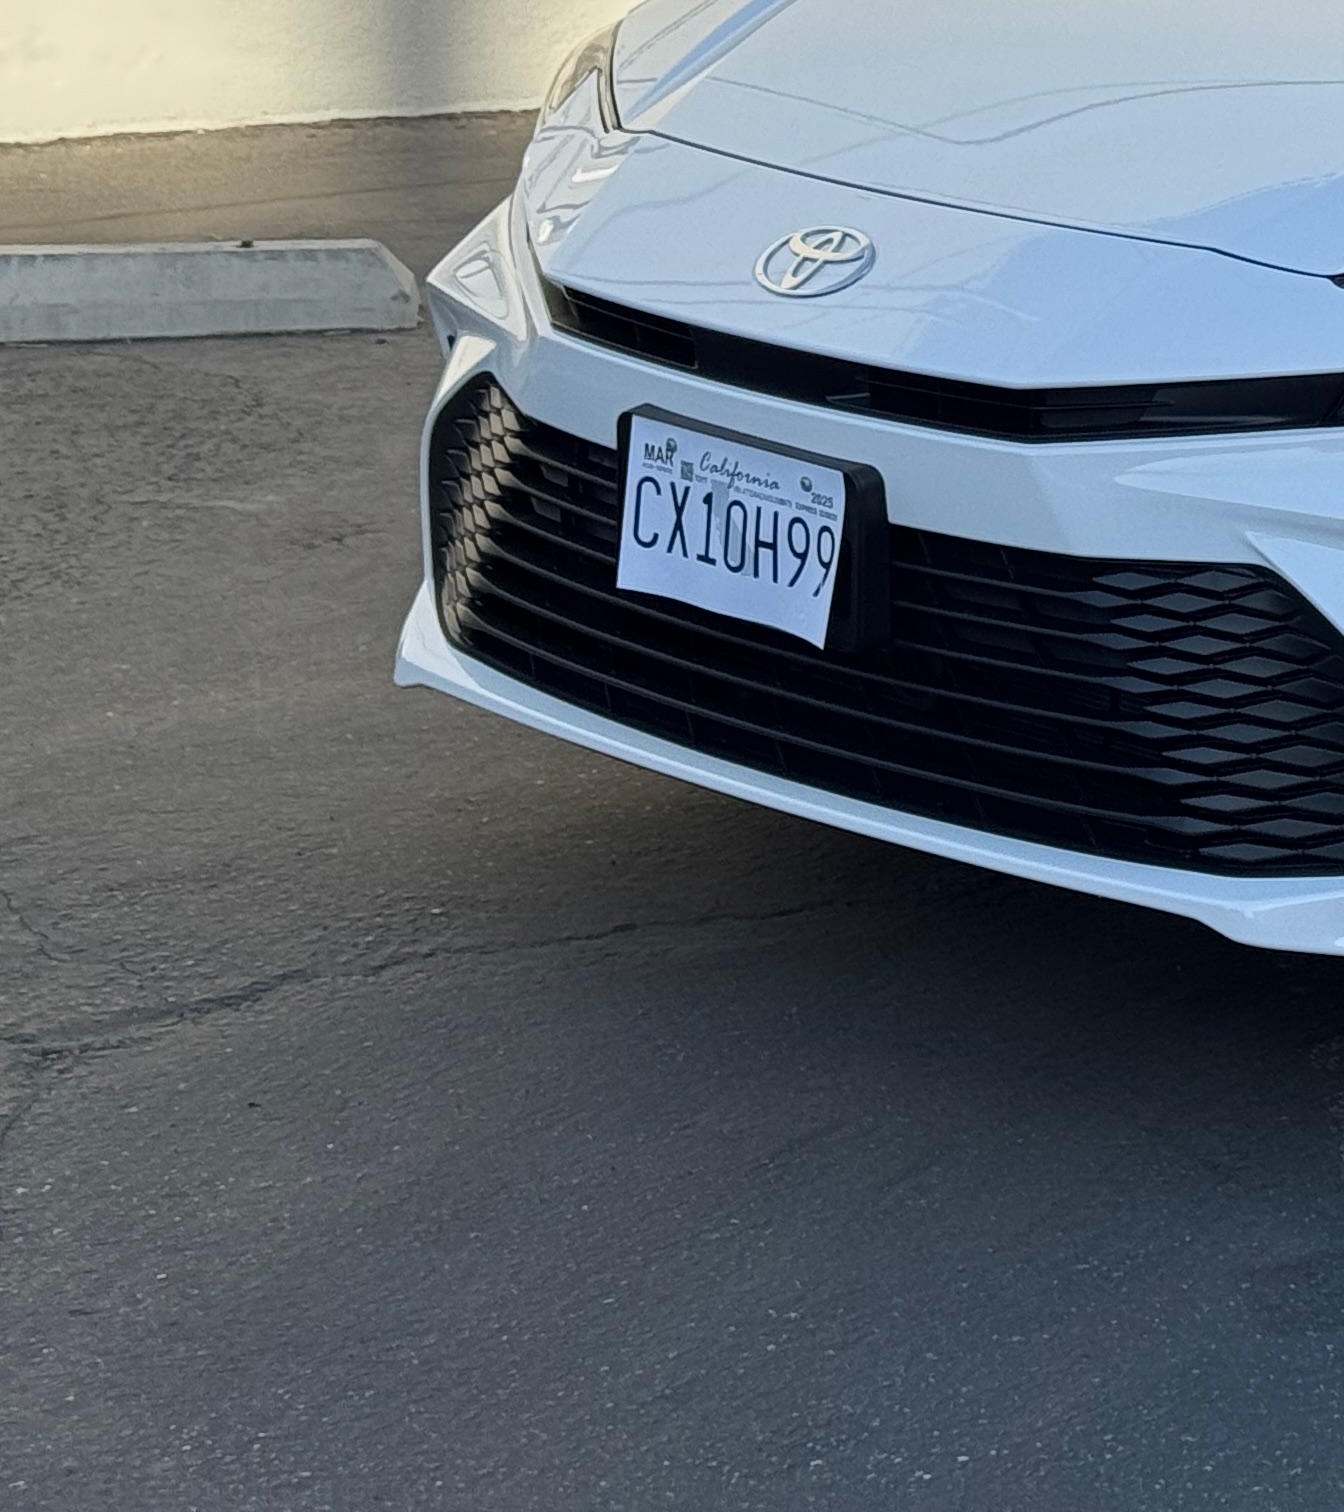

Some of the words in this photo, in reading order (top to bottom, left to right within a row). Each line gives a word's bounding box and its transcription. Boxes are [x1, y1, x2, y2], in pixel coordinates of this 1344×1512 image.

[643, 441, 675, 467] MAR
[699, 451, 782, 490] California
[810, 491, 834, 509] 2025
[633, 476, 836, 598] CX10H99
